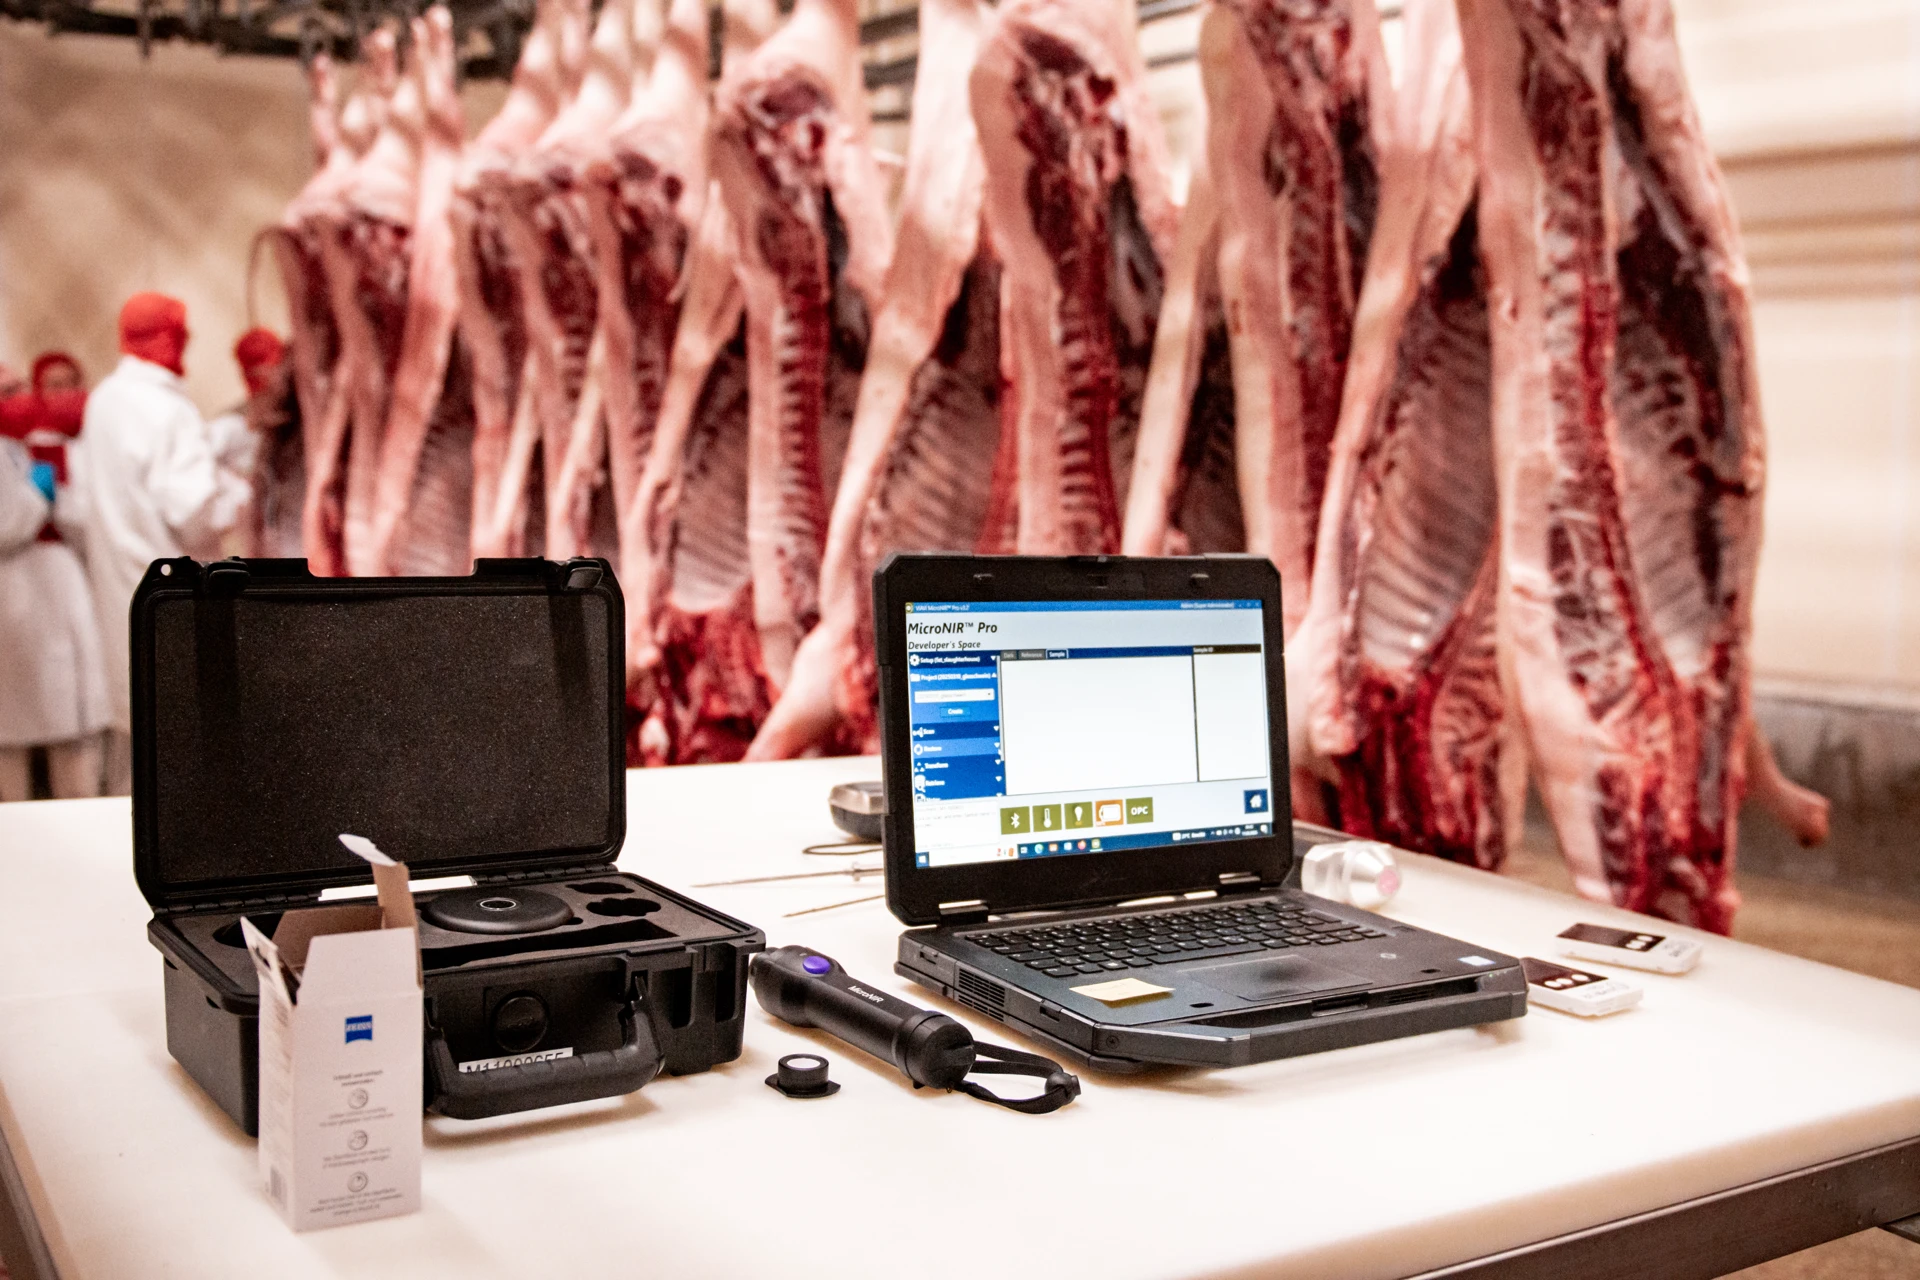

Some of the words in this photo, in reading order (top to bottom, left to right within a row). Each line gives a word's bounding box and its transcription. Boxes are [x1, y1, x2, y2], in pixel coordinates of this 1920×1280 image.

[978, 622, 998, 634] Pro
[908, 642, 955, 652] Developer's
[958, 640, 981, 651] Space
[1130, 806, 1149, 816] OPC
[847, 985, 884, 1003] MicroNIR
